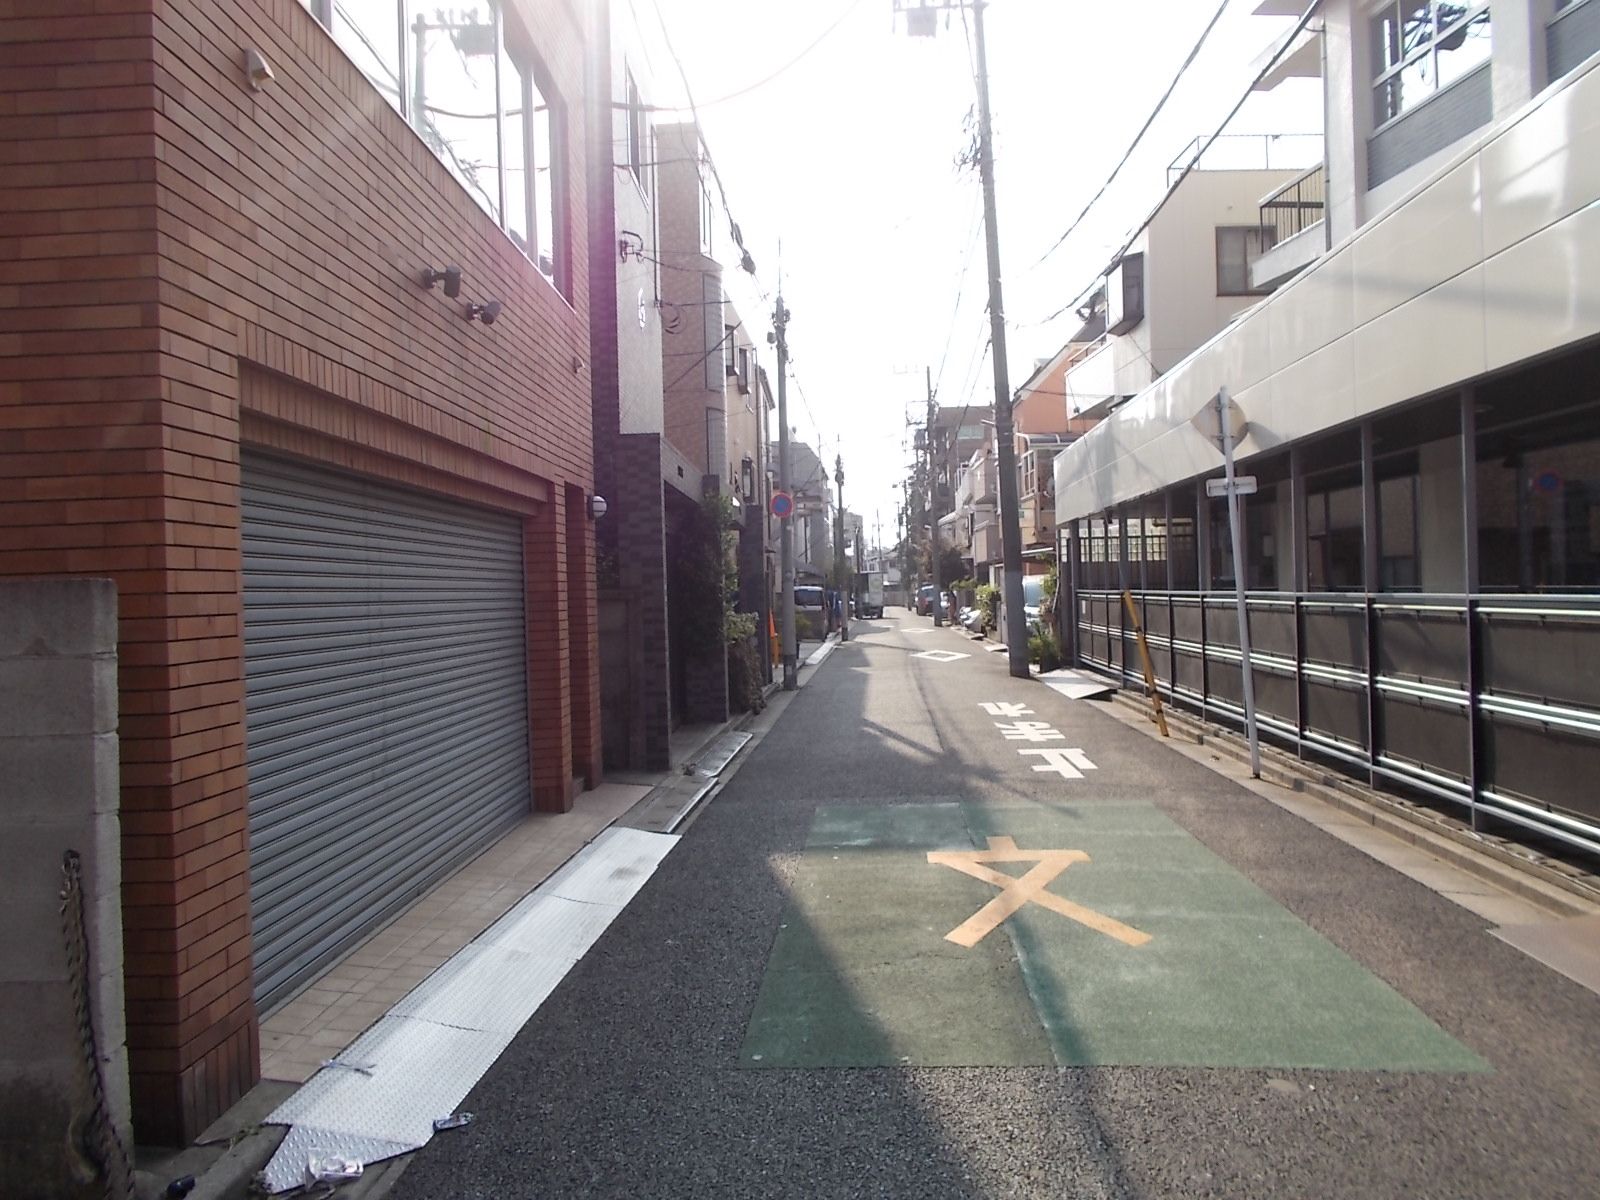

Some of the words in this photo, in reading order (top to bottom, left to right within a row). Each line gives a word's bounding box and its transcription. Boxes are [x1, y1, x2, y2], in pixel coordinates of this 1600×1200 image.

[977, 701, 1098, 778] 止まれ
[927, 836, 1152, 947] 文
